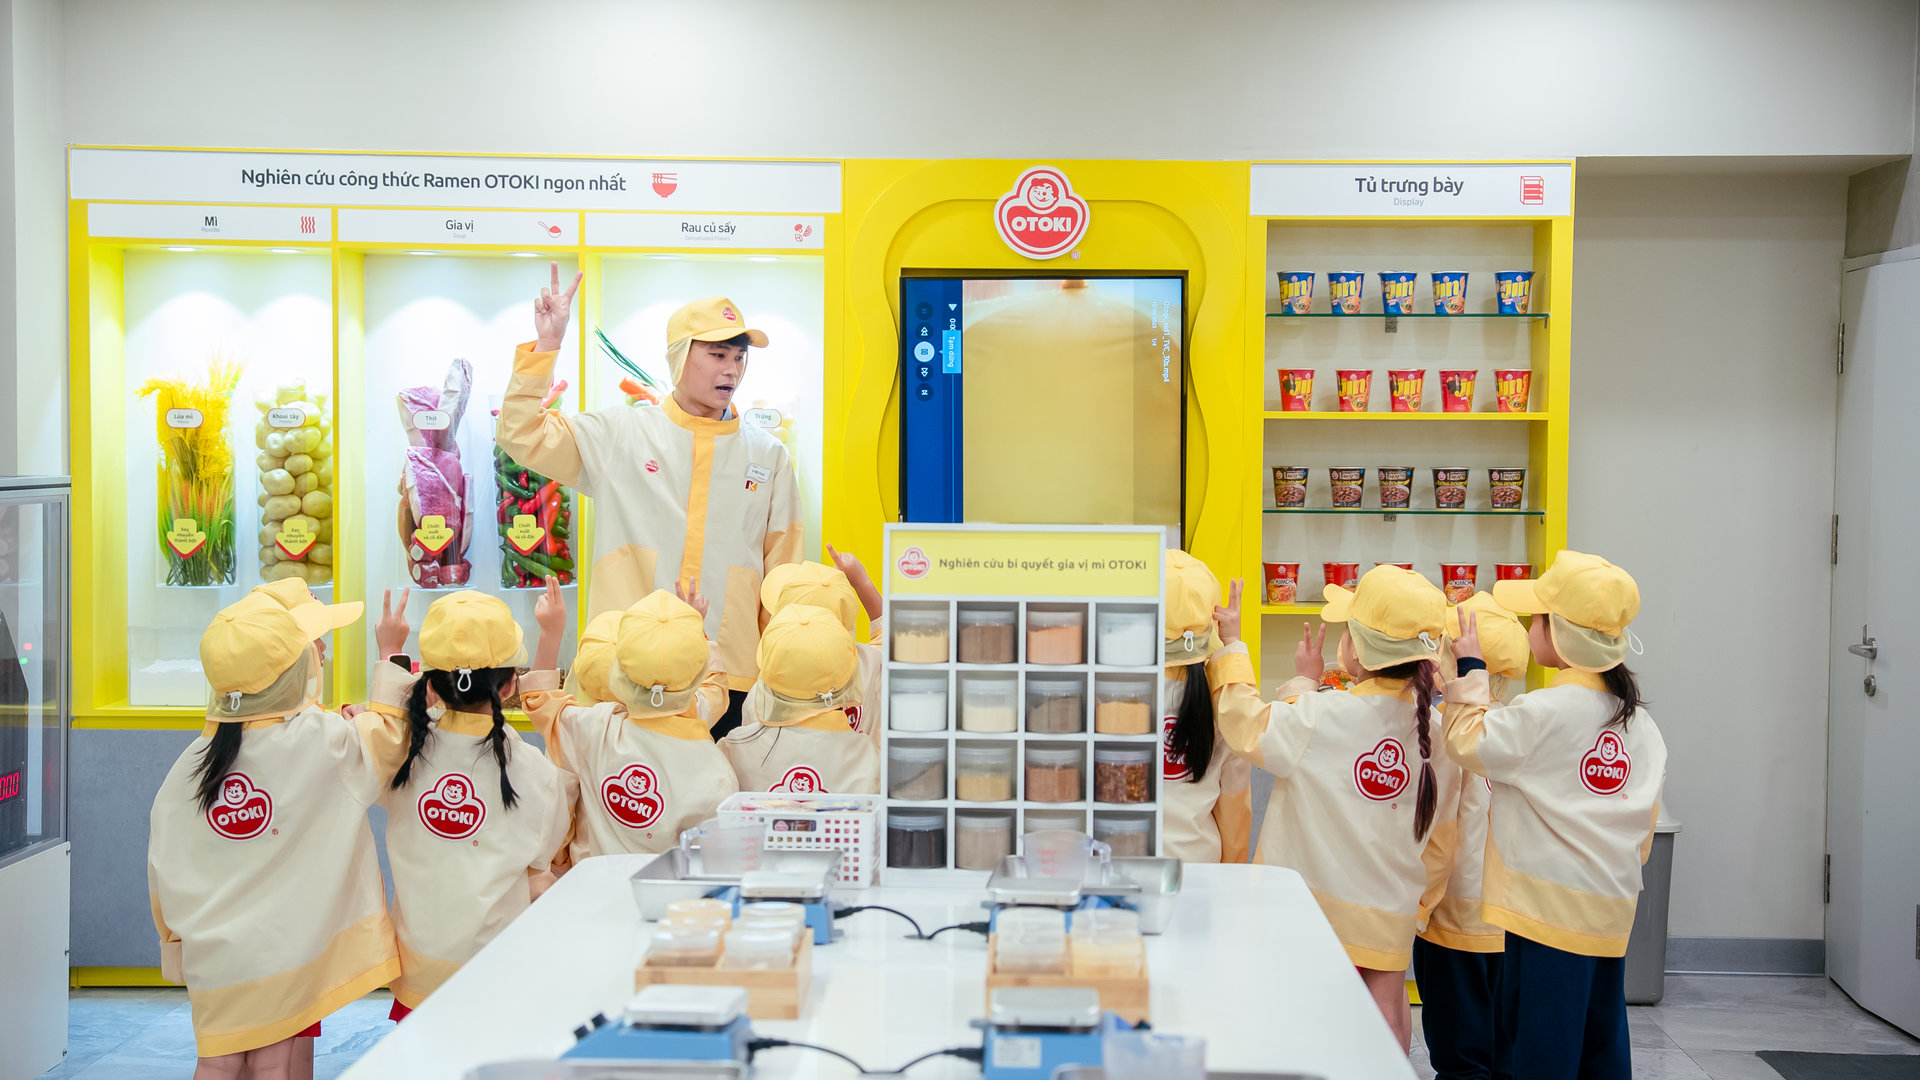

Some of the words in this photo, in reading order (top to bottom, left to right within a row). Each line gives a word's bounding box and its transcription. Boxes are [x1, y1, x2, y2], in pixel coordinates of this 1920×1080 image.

[241, 168, 301, 187] Nghiên
[305, 169, 335, 186] cứu
[339, 170, 378, 190] công
[382, 171, 420, 187] thức
[424, 173, 480, 188] Ramen
[484, 174, 539, 190] OTOKI
[544, 178, 585, 193] ngon
[589, 172, 627, 191] nhất
[1355, 176, 1377, 193] Tủ
[1381, 177, 1429, 196] trưng
[1433, 176, 1464, 196] bày
[1393, 197, 1425, 206] Display
[204, 215, 218, 227] Mì
[445, 219, 463, 230] Gia
[464, 219, 474, 233] vị
[681, 222, 702, 233] Rau
[703, 221, 716, 233] củ
[718, 221, 737, 235] sấy
[1011, 216, 1072, 232] OTOKI
[939, 557, 980, 571] Nghiên
[983, 558, 1004, 569] cứu
[1021, 557, 1054, 571] quyết
[1058, 559, 1075, 571] gia
[1078, 559, 1088, 572] vị
[1108, 559, 1147, 570] OTOKI
[1361, 768, 1401, 789] OTOKI
[1586, 764, 1624, 780] OTOKI
[609, 791, 653, 819] OTOKI
[217, 805, 264, 826] OTOKI
[427, 807, 474, 826] OTOKI
